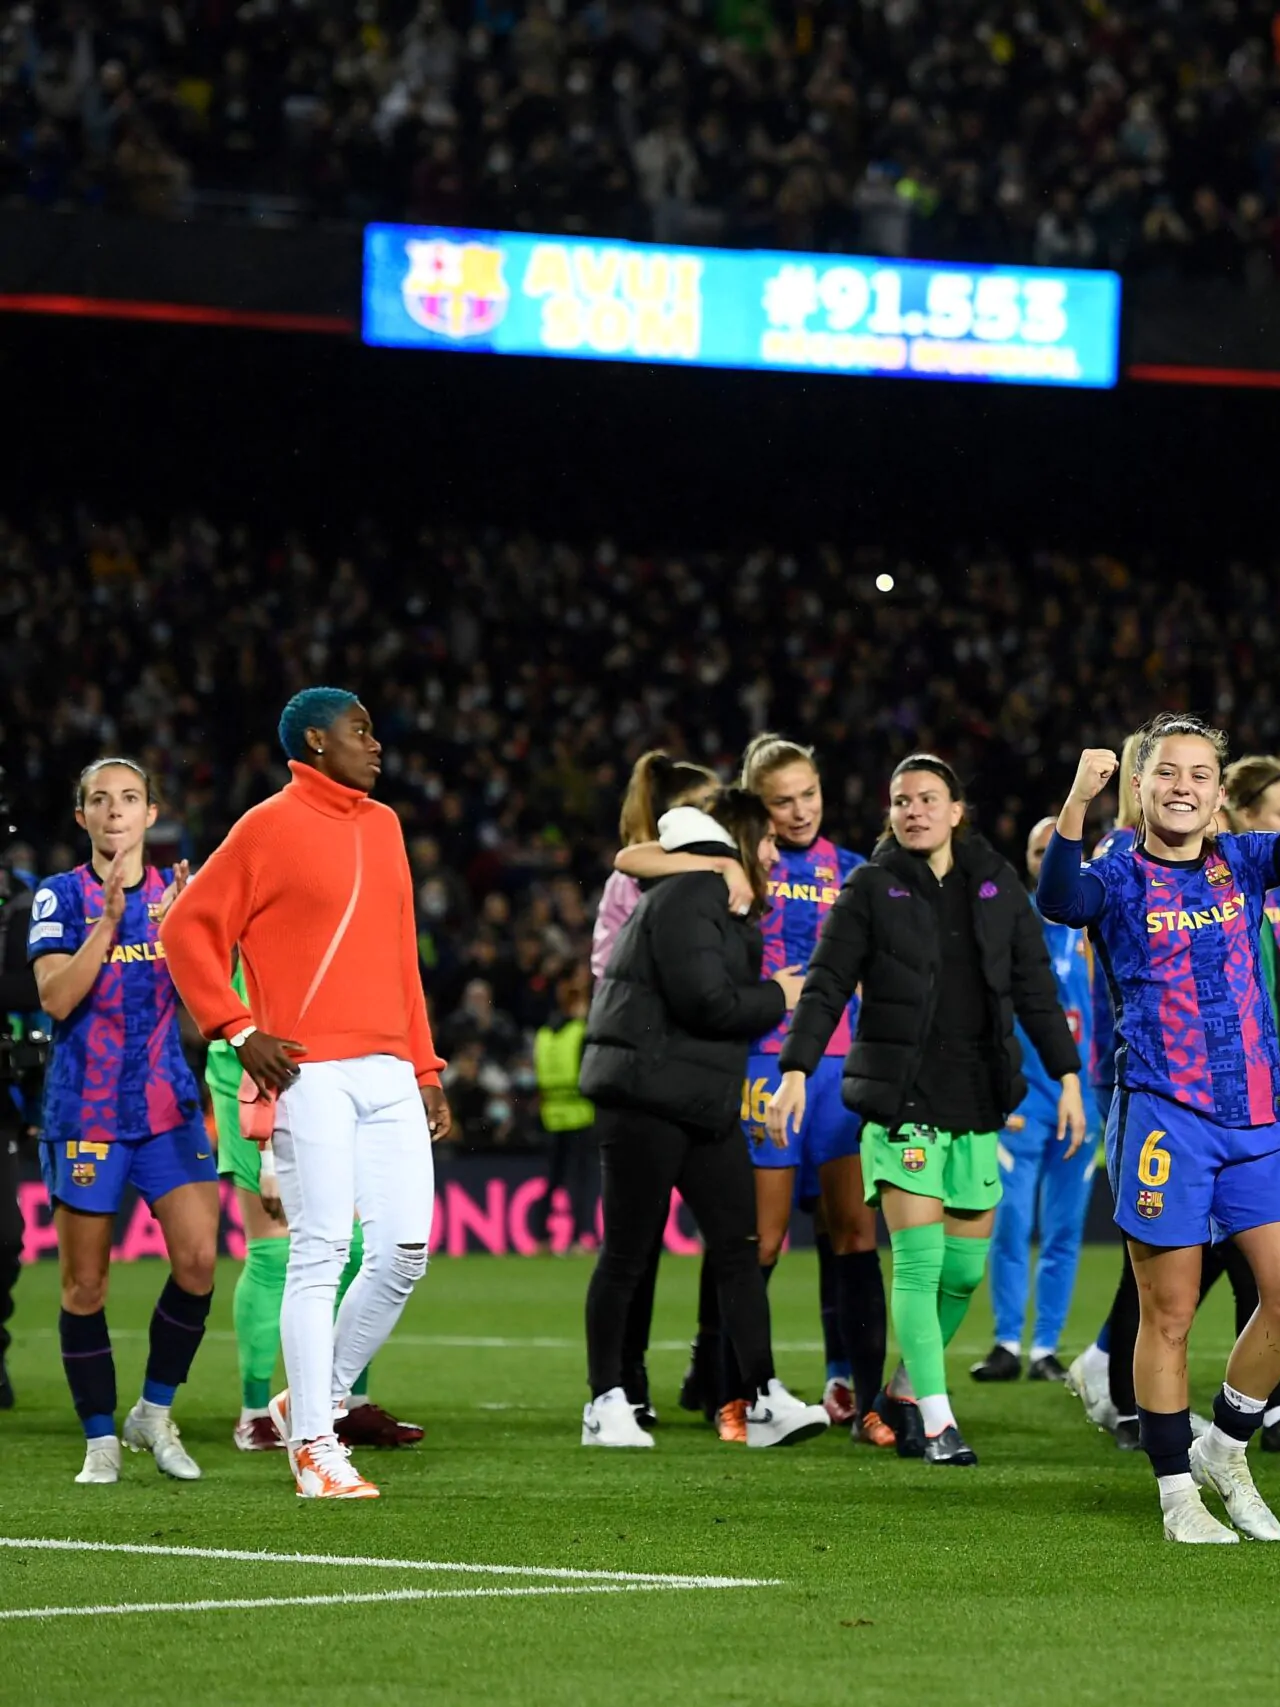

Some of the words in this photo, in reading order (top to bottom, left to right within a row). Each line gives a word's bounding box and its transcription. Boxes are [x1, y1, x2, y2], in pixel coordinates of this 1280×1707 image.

[522, 243, 704, 298] AVUI
[541, 296, 703, 359] SOM
[762, 265, 1068, 342] #91.553
[1146, 892, 1245, 933] STANLEY
[1137, 1130, 1171, 1187] 6
